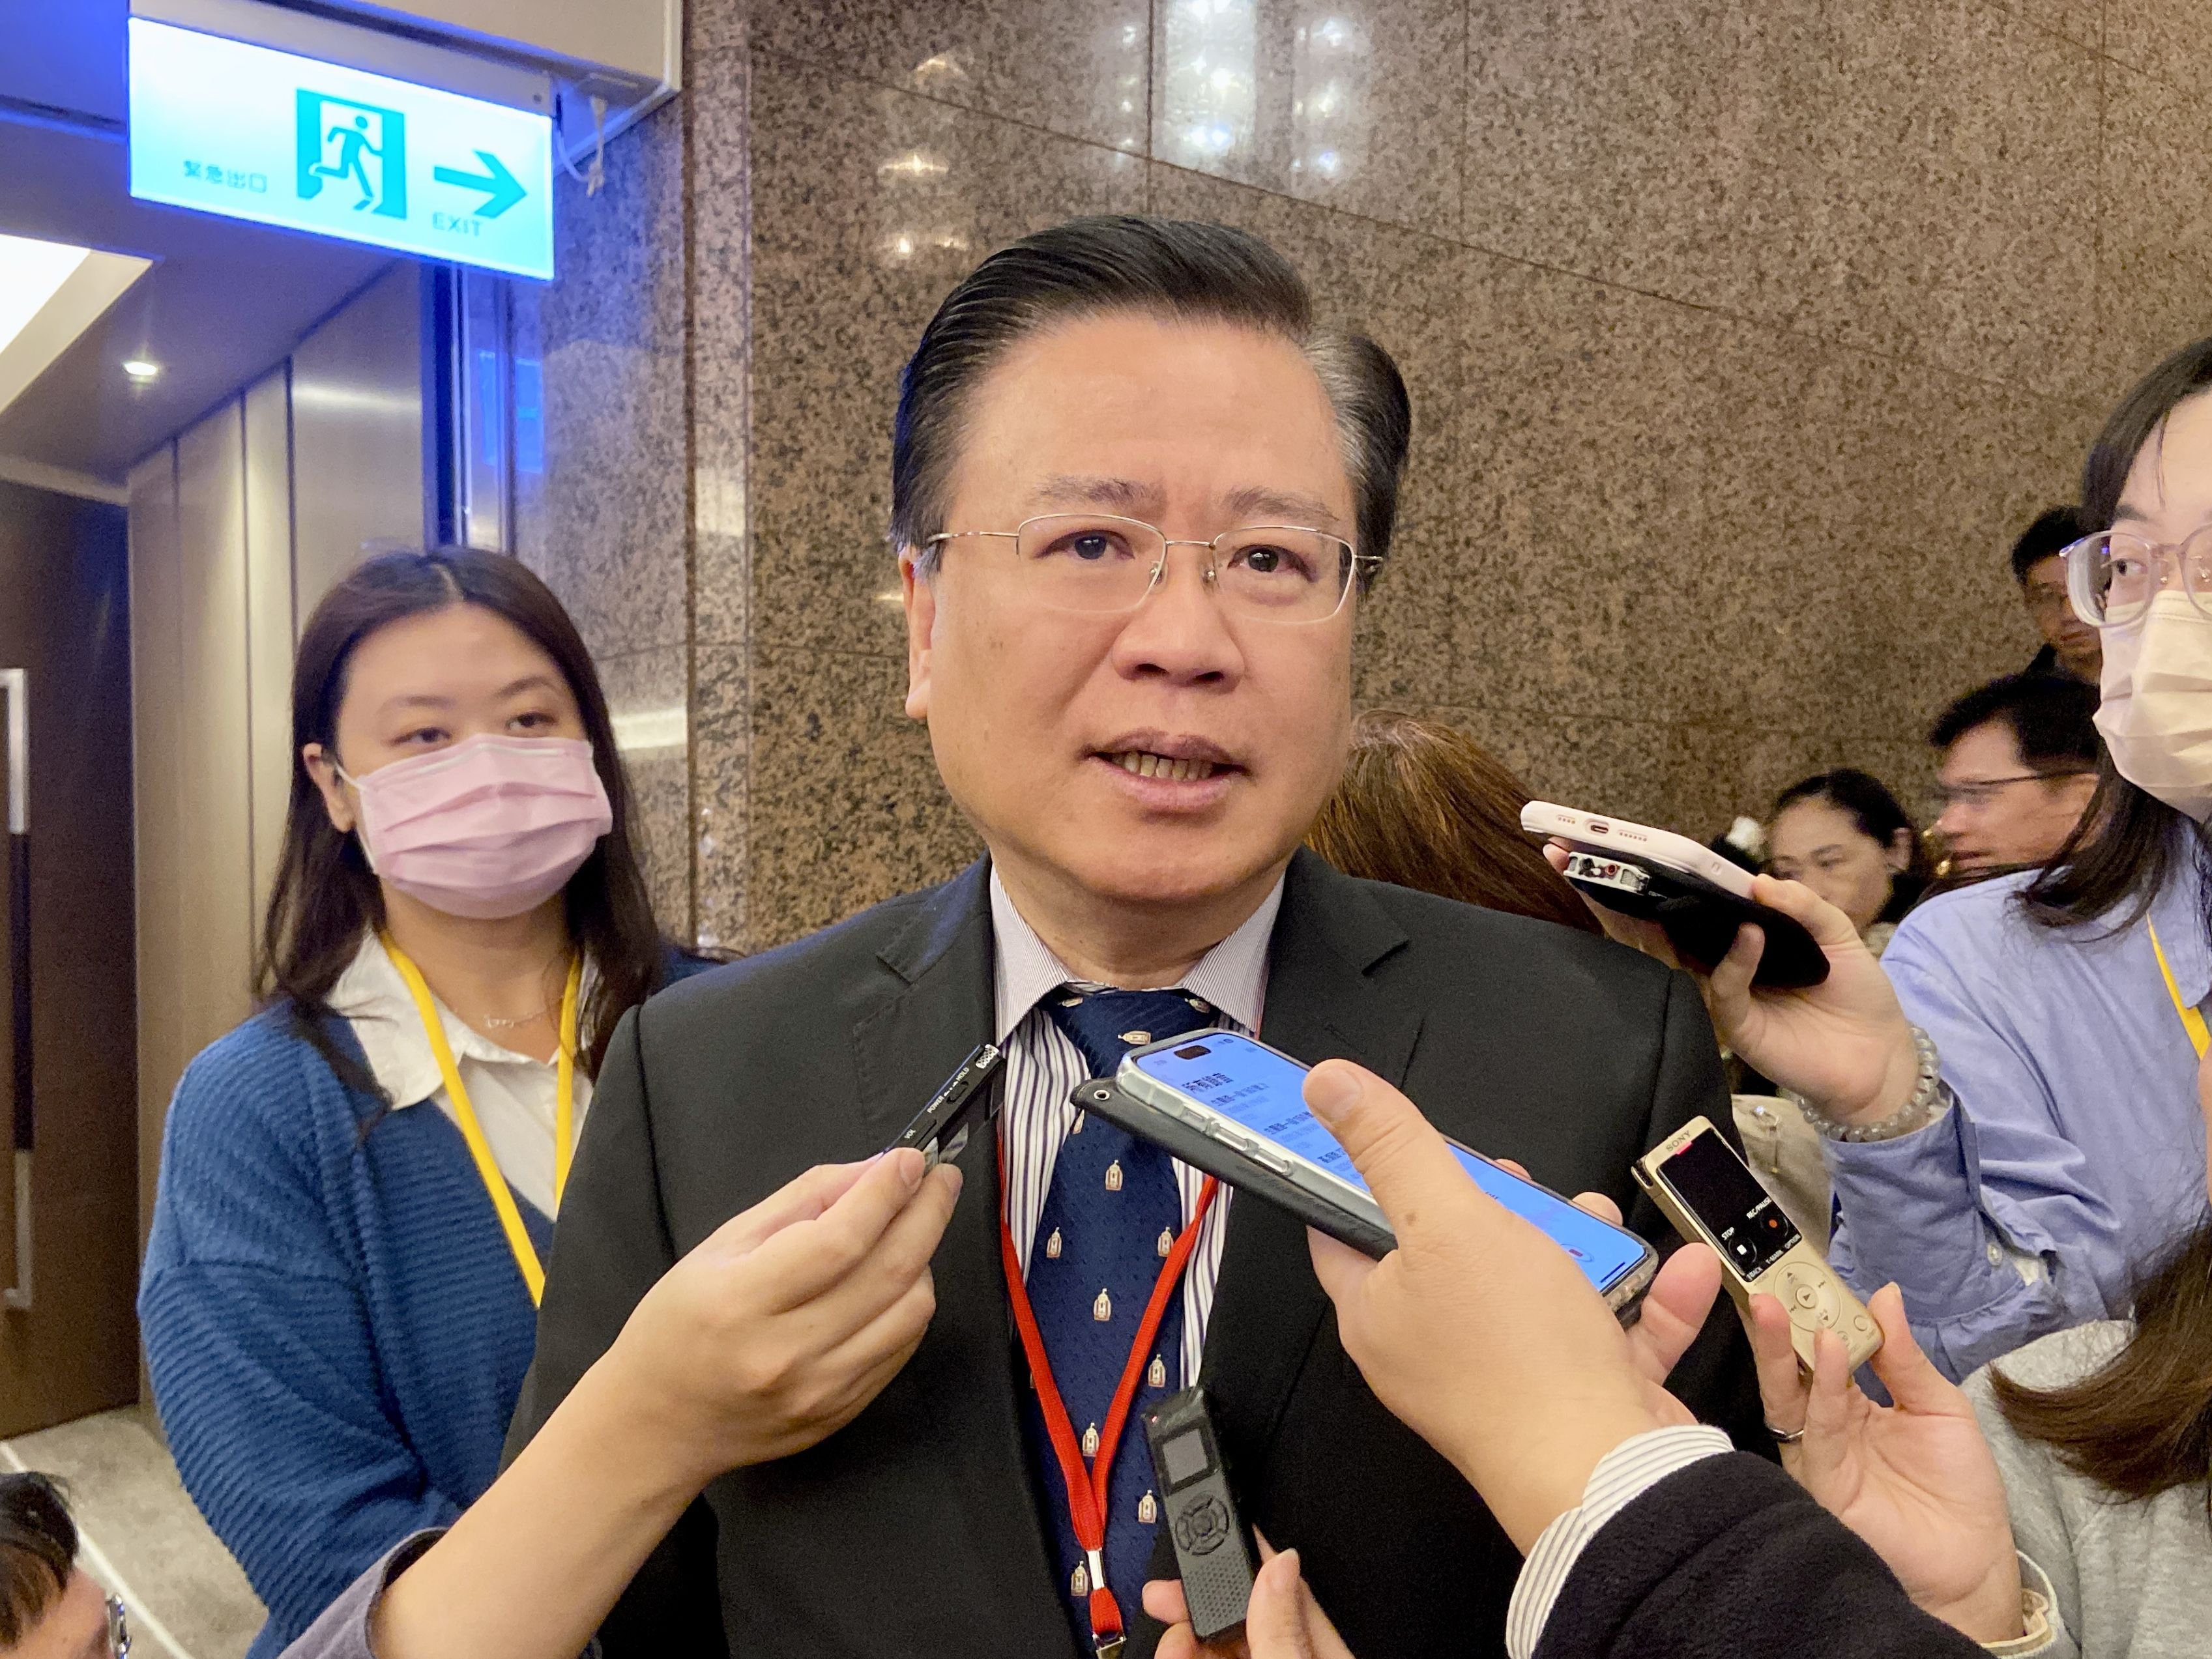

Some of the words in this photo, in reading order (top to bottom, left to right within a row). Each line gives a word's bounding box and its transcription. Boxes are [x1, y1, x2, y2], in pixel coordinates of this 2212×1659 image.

[184, 160, 267, 194] 緊急出口
[432, 211, 481, 237] EXIT
[955, 1067, 970, 1082] HOLD
[927, 1095, 945, 1114] POWER
[904, 1129, 917, 1140] VOL
[1666, 1130, 1691, 1152] SONY
[1721, 1226, 1735, 1241] STOP
